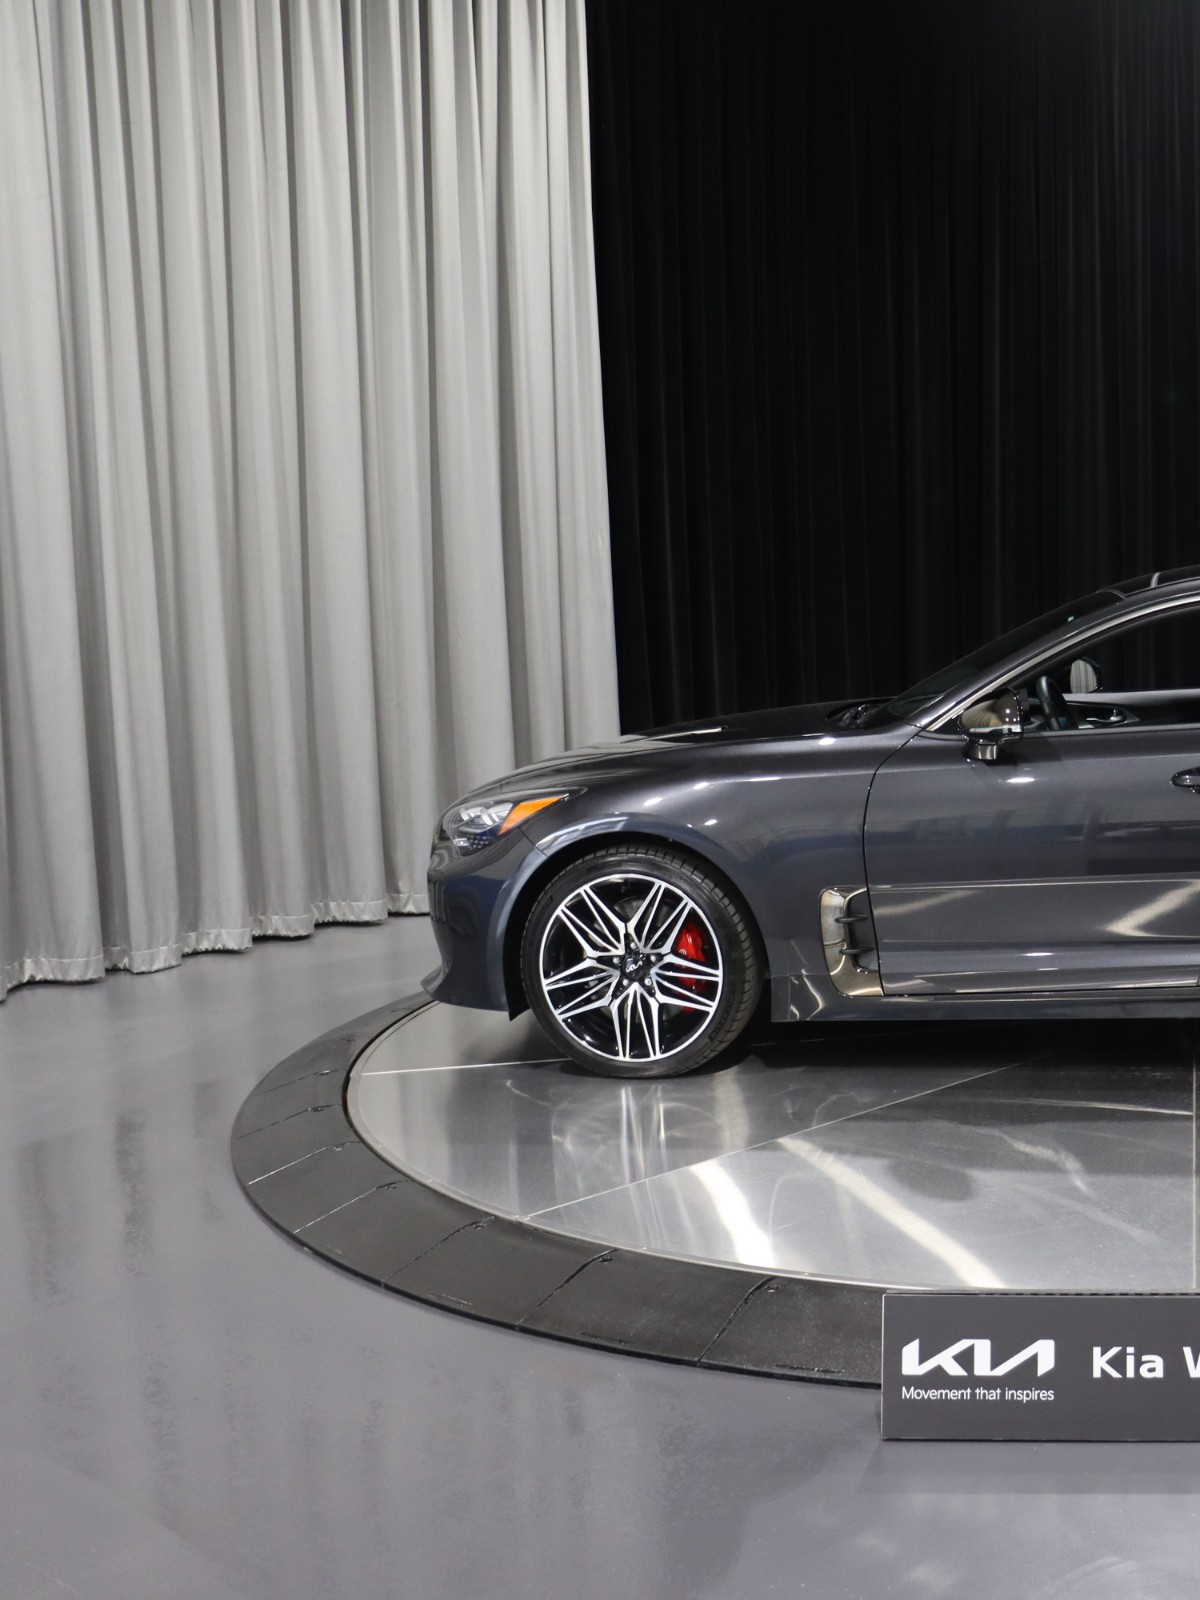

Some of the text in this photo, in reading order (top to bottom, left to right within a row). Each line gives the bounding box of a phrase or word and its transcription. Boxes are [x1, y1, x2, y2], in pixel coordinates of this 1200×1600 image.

[901, 1338, 1055, 1377] KIA
[1092, 1346, 1164, 1378] Kia
[901, 1386, 1055, 1404] Movement that inspires
